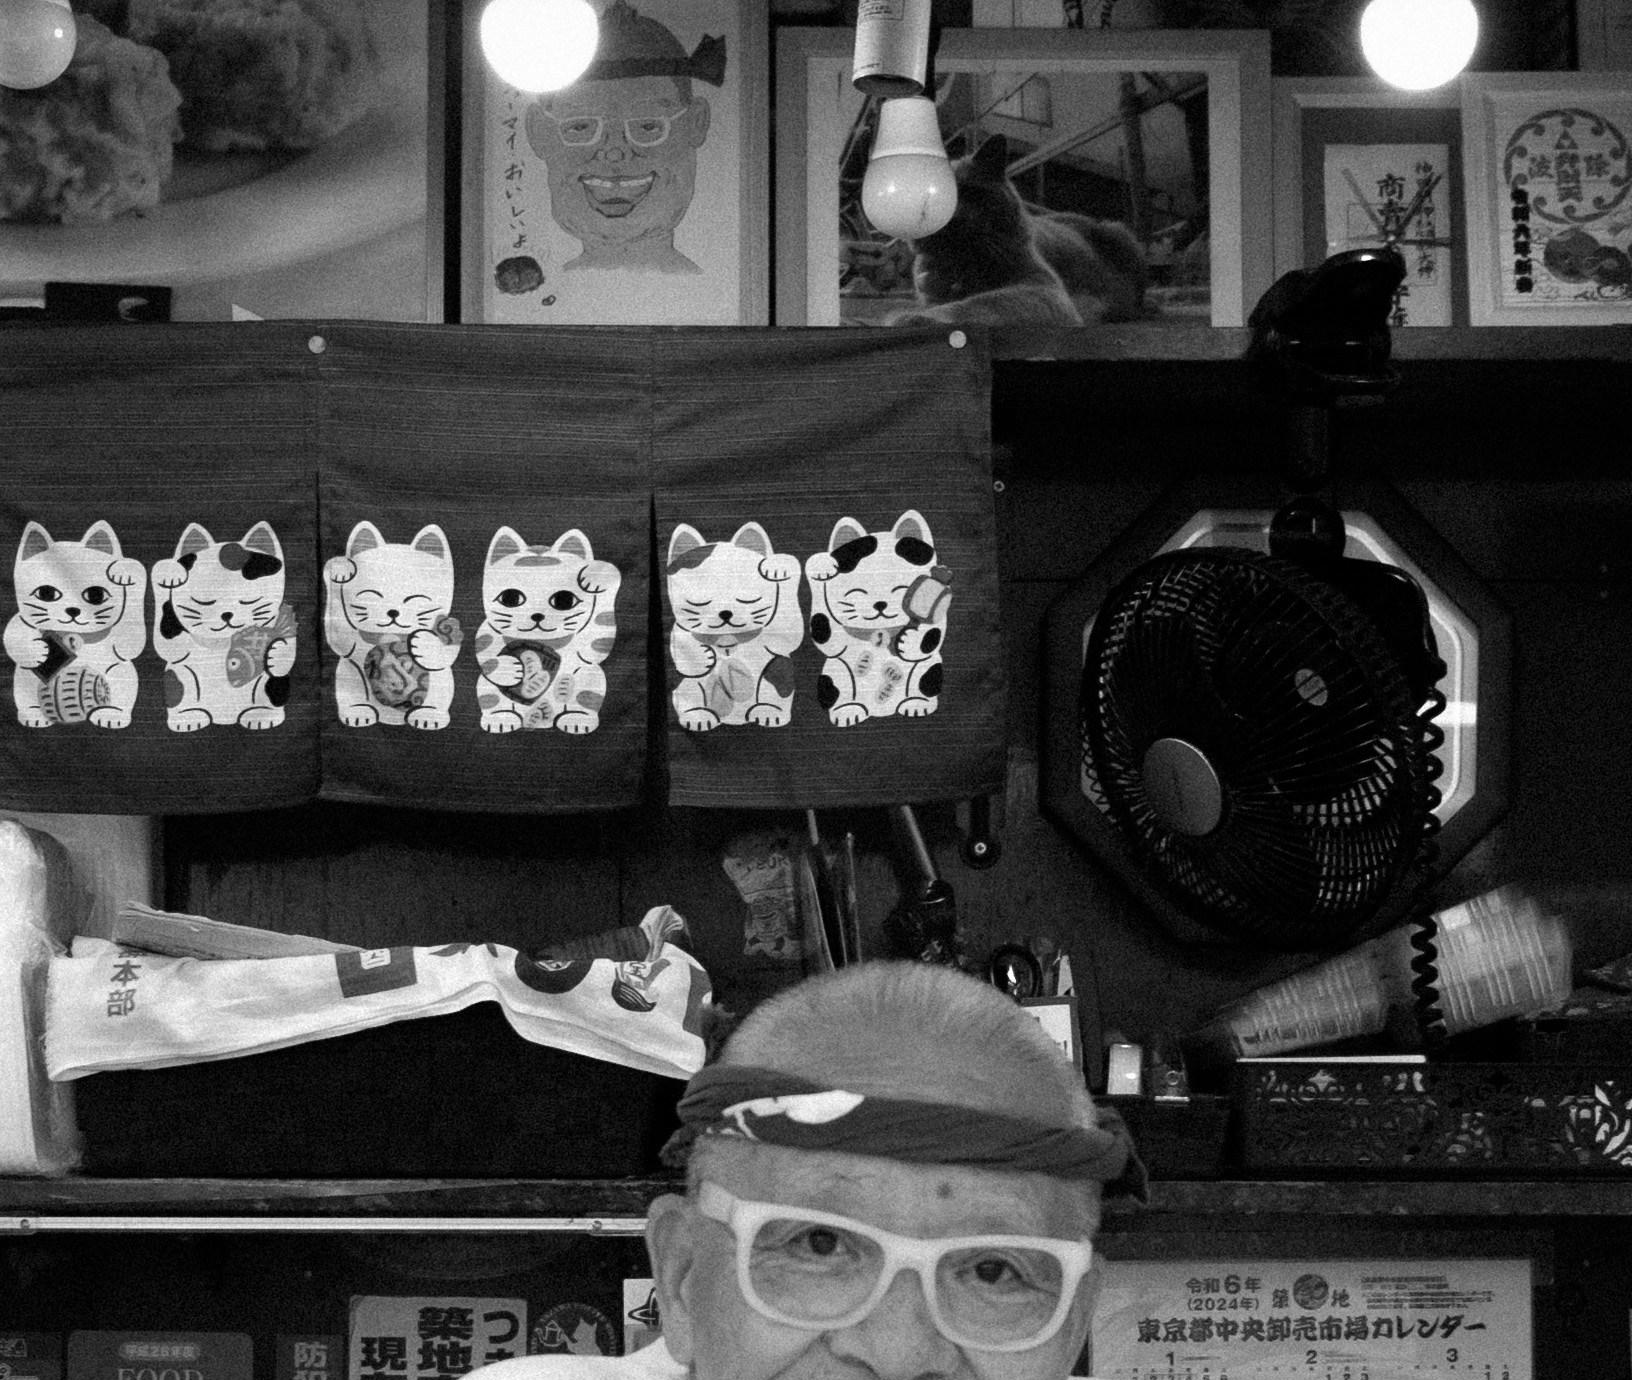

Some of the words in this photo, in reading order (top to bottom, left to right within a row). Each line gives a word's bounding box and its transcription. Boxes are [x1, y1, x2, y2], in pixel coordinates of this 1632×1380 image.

[106, 952, 143, 1018] 本部
[1186, 1274, 1262, 1295] 令和6年
[1136, 1314, 1487, 1343] 東京都中央卸売市場カレンダー
[1165, 1352, 1174, 1367] 1
[1305, 1350, 1318, 1365] 2
[1446, 1348, 1459, 1364] 3
